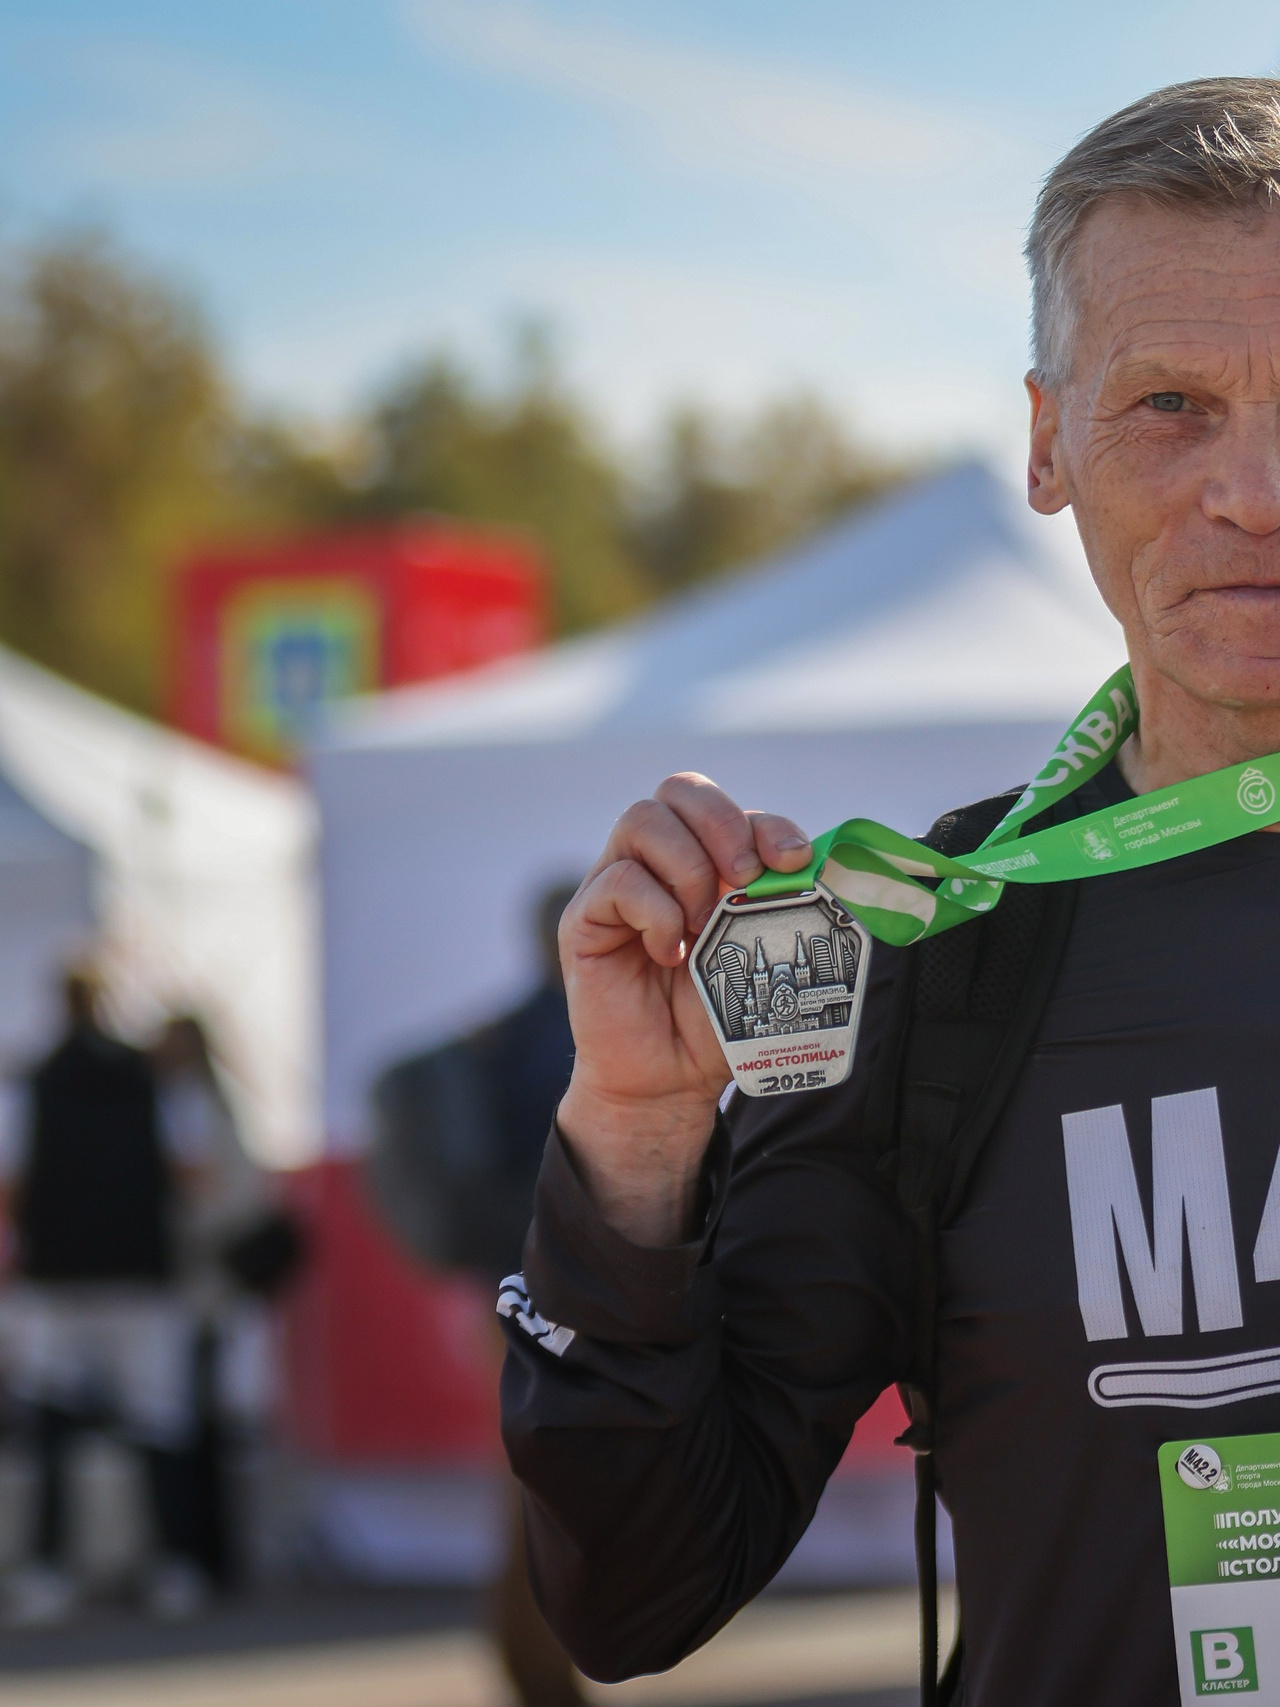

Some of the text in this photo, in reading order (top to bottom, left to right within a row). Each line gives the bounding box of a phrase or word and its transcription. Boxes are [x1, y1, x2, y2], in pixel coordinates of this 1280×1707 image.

[995, 688, 1134, 829] СКВА
[1112, 797, 1179, 829] Департамент
[1118, 820, 1154, 839] спорта
[1124, 818, 1202, 851] города Москвы
[758, 1043, 820, 1057] ПОЛУМАРАФОН
[764, 1070, 822, 1092] 2025
[1184, 1448, 1218, 1482] M42.2
[1237, 1481, 1262, 1490] города
[1201, 1679, 1250, 1692] КЛАСТЕР
